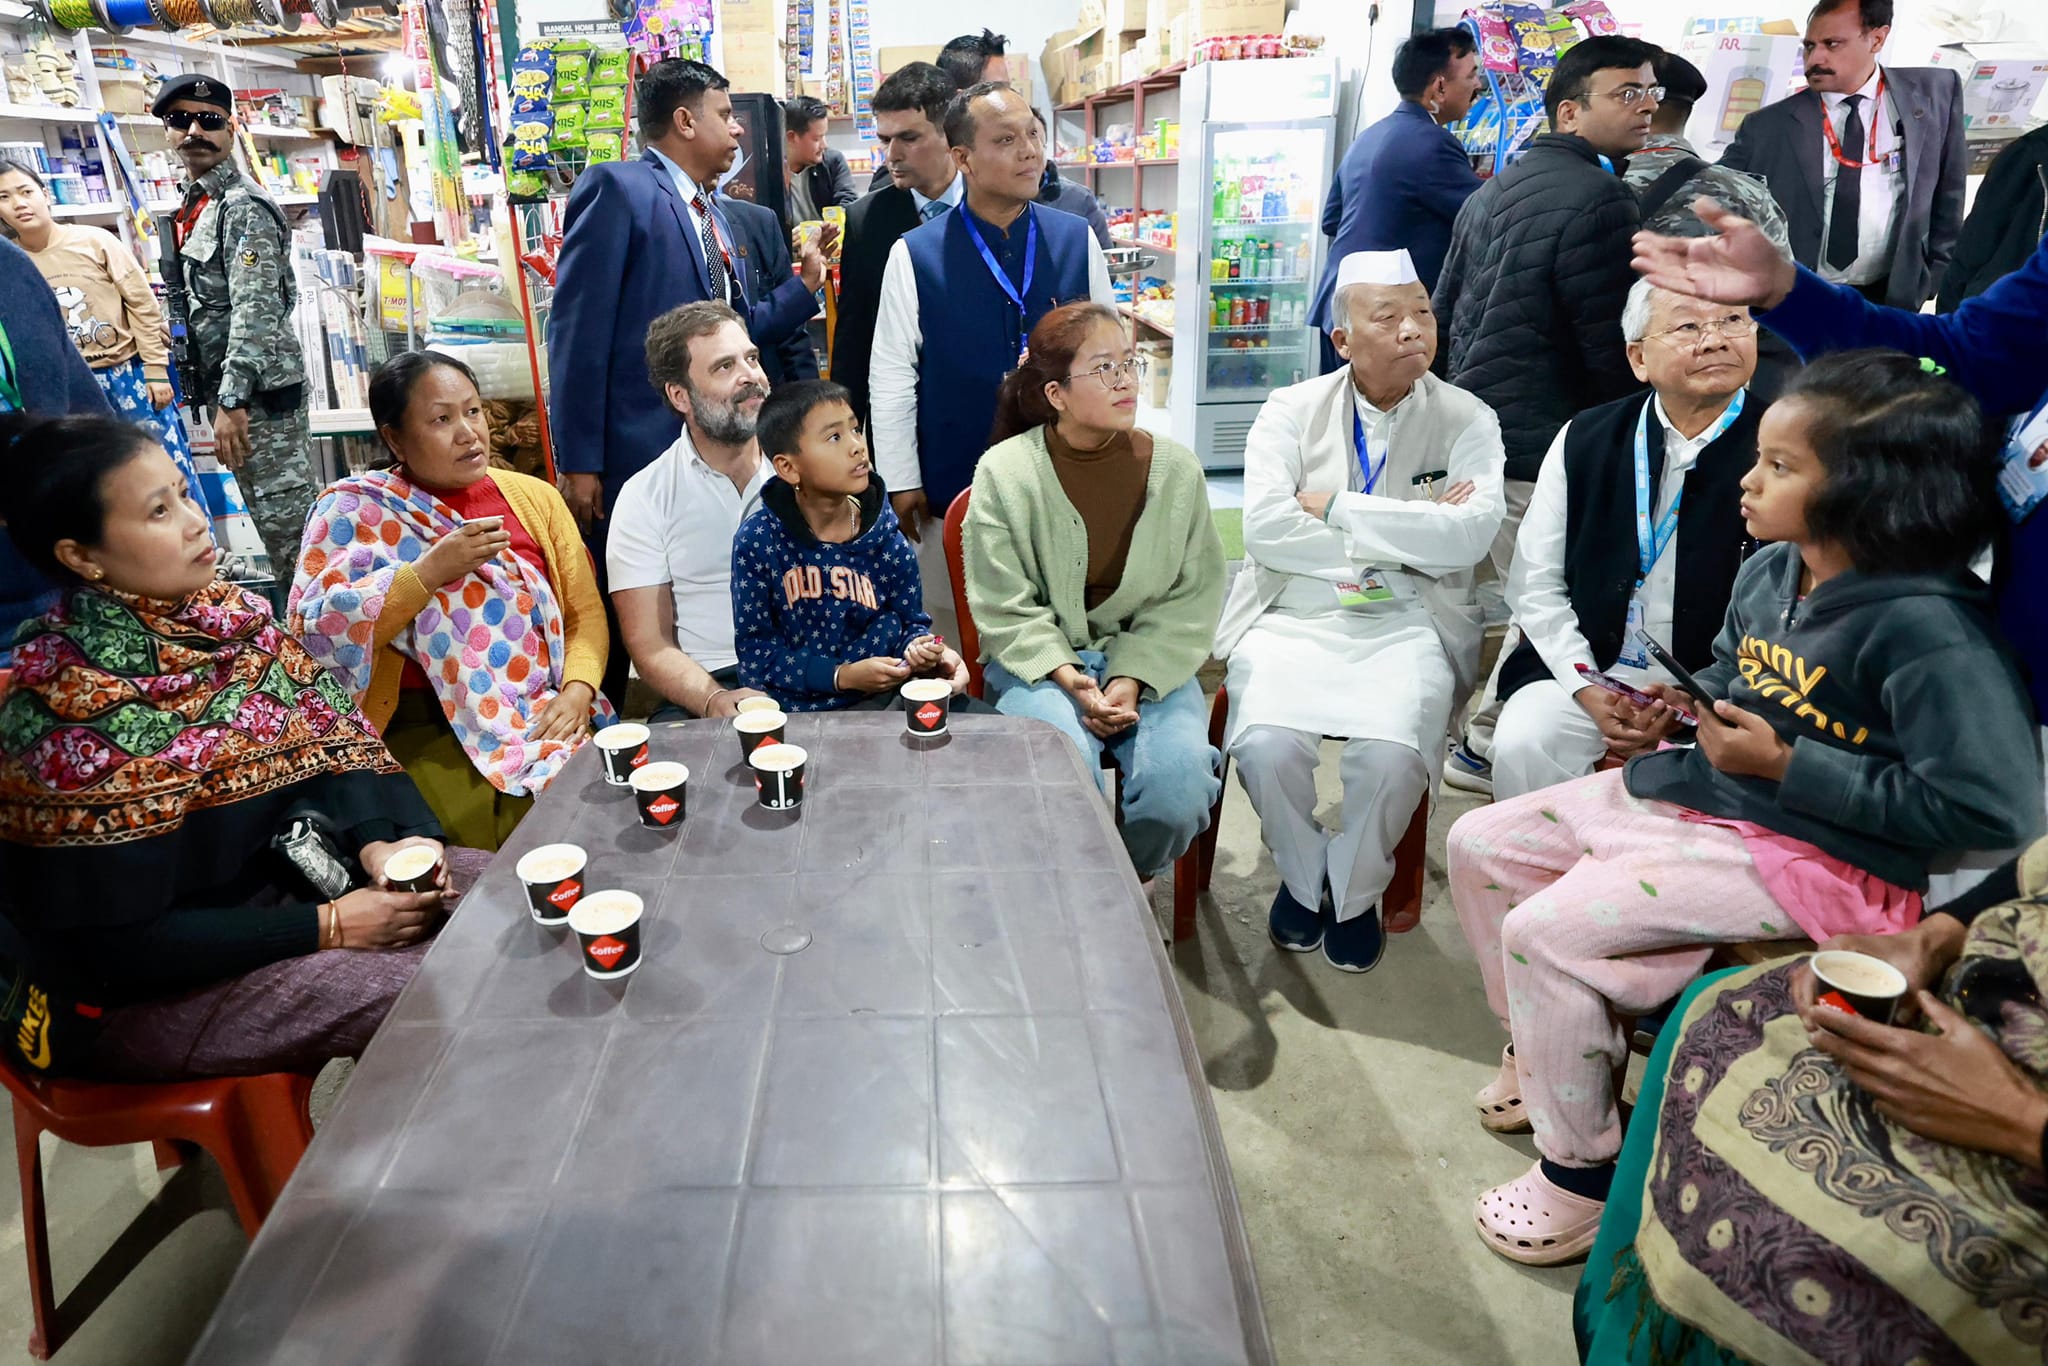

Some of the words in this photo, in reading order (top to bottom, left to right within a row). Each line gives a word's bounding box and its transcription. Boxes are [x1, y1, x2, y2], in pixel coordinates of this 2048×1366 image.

[544, 25, 573, 33] MANGAL
[575, 24, 595, 32] HOME
[596, 23, 620, 31] SERVICE
[1719, 38, 1740, 51] RR
[593, 99, 614, 108] Stix
[783, 566, 822, 610] OLD
[831, 566, 879, 611] STAR
[917, 711, 940, 719] Coffee
[649, 803, 677, 813] Coffee
[551, 885, 580, 902] Coffee
[590, 944, 624, 956] Coffee
